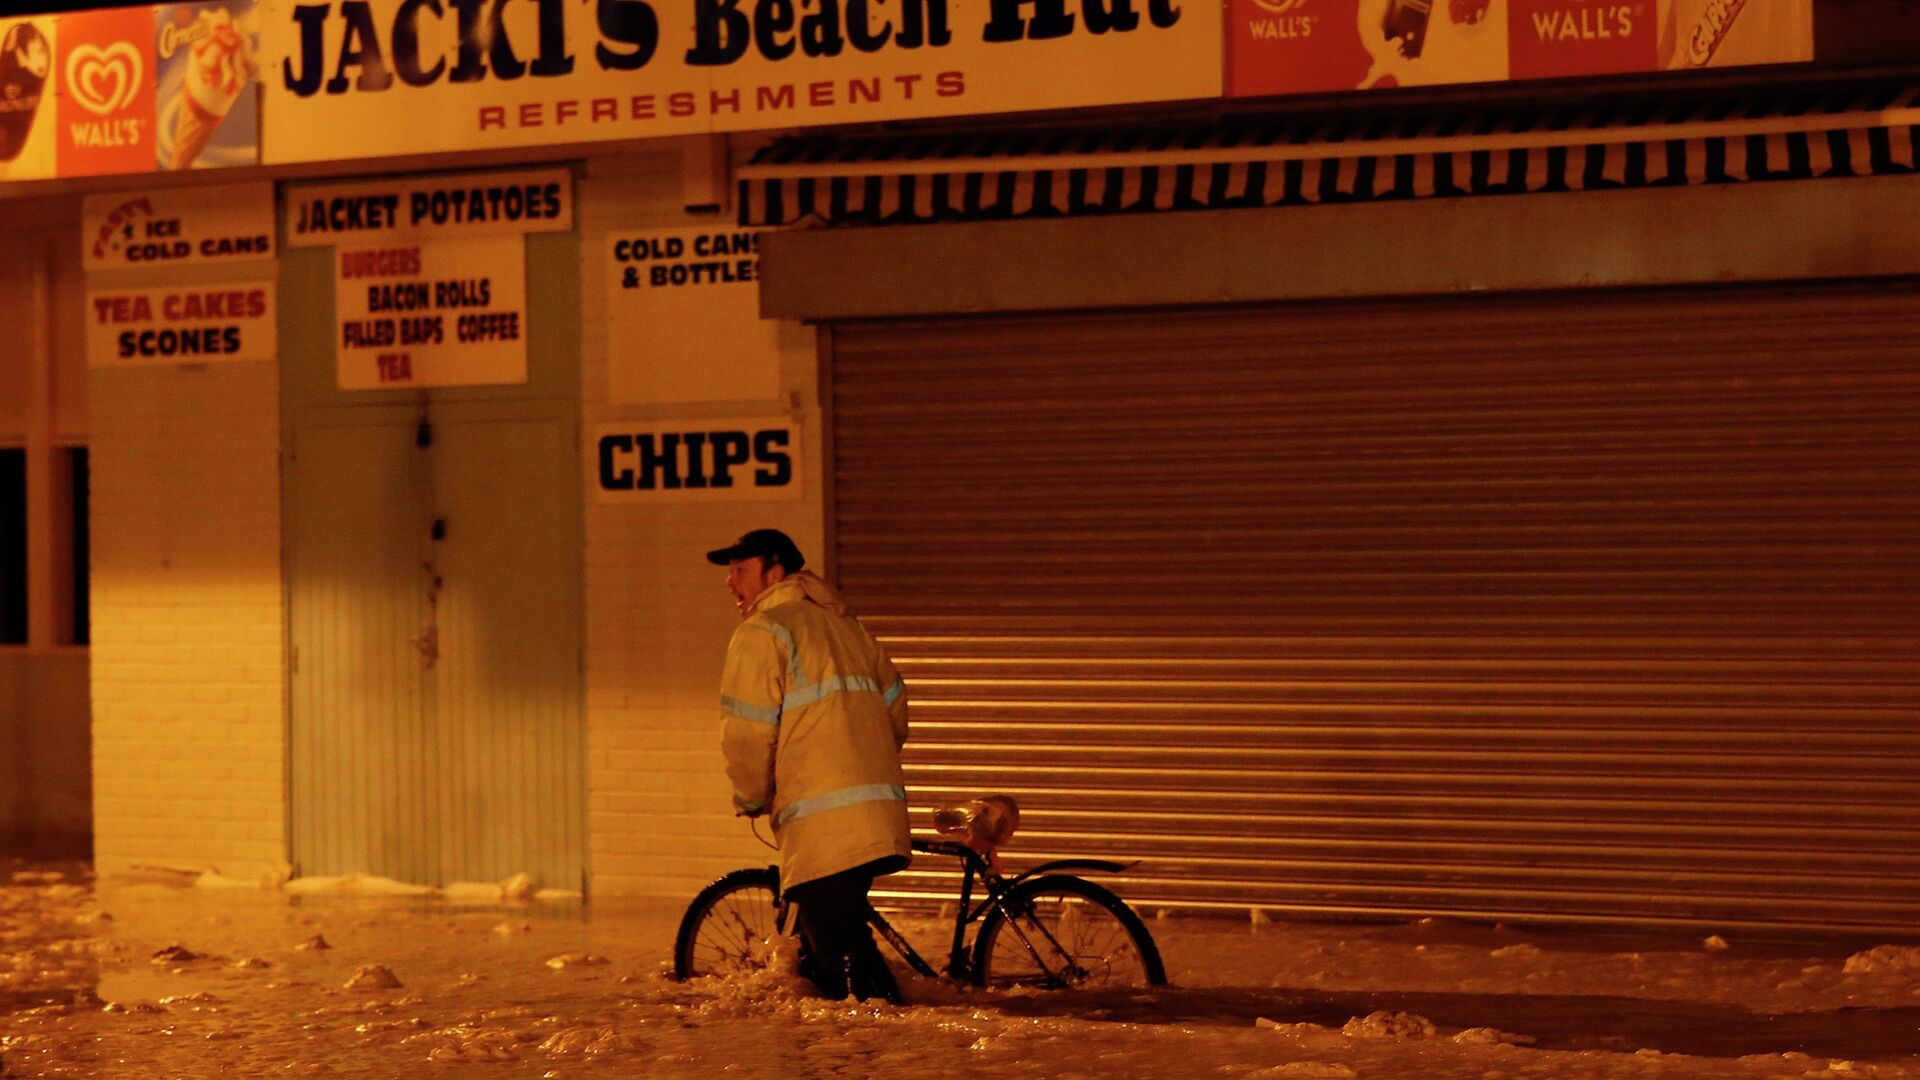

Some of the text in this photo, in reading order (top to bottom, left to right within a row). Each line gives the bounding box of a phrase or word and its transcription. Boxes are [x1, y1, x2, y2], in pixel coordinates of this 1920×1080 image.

[1250, 16, 1312, 39] WALL'S
[1532, 6, 1632, 42] WALL'S
[283, 0, 659, 98] JACKIS
[684, 0, 952, 66] Beach
[478, 71, 967, 131] REFRESHMENTS
[70, 118, 141, 147] WALL'S
[296, 183, 562, 233] JACKET POTATOES
[146, 219, 180, 238] ICE
[125, 235, 269, 261] COLD CANS
[341, 246, 422, 280] BURGERS
[614, 237, 684, 261] COLD
[622, 266, 640, 289] &
[93, 289, 266, 325] TEA CAKES
[368, 278, 490, 313] BACON ROLLS
[118, 326, 241, 359] SCONES
[342, 312, 519, 349] FILLED BAPS COFFEE
[376, 353, 413, 383] TEA
[598, 428, 792, 491] CHIPS
